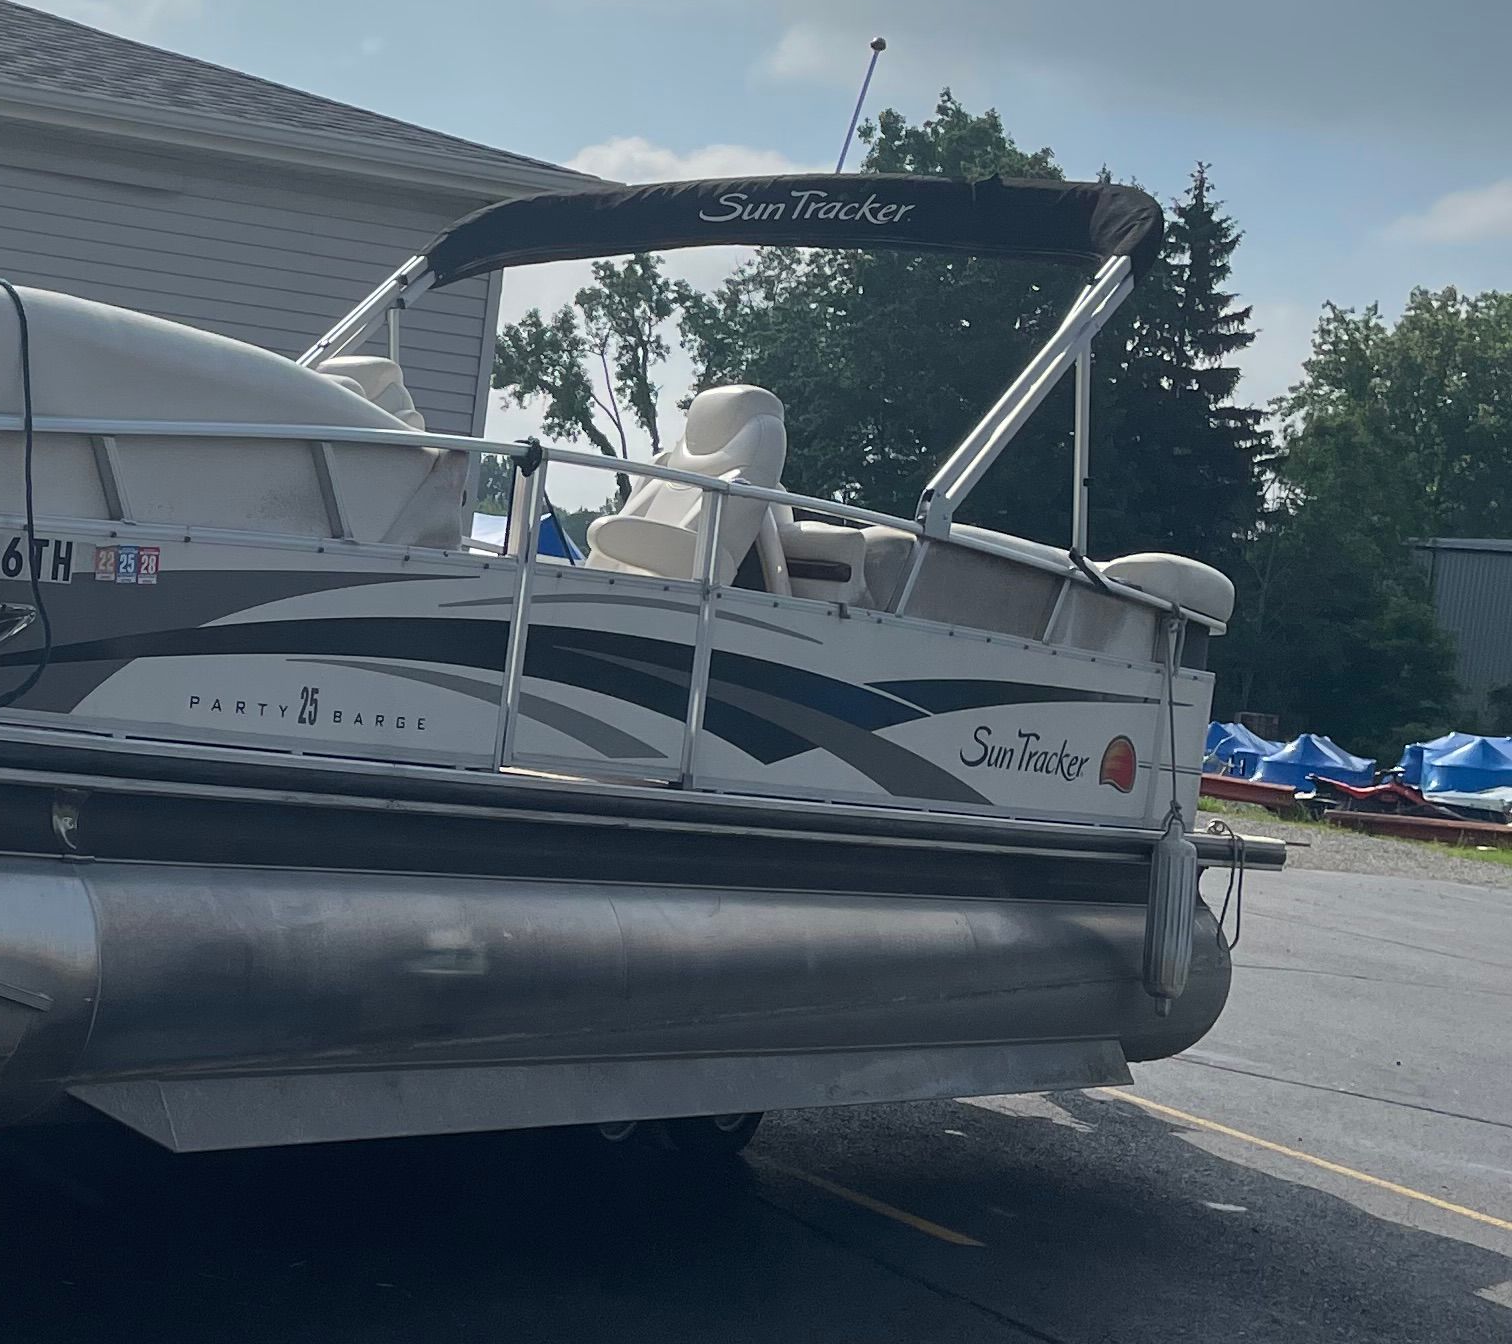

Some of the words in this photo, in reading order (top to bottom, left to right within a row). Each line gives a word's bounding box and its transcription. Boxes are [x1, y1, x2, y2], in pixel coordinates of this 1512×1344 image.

[699, 193, 786, 222] Sun
[790, 190, 916, 225] Tracker
[98, 550, 115, 573] 22
[119, 553, 135, 573] 25
[140, 555, 157, 575] 28
[189, 695, 289, 719] PARTY
[297, 686, 320, 725] 25
[332, 710, 426, 731] BARGE
[959, 725, 1015, 767] Sun
[1017, 728, 1090, 782] Tracker
